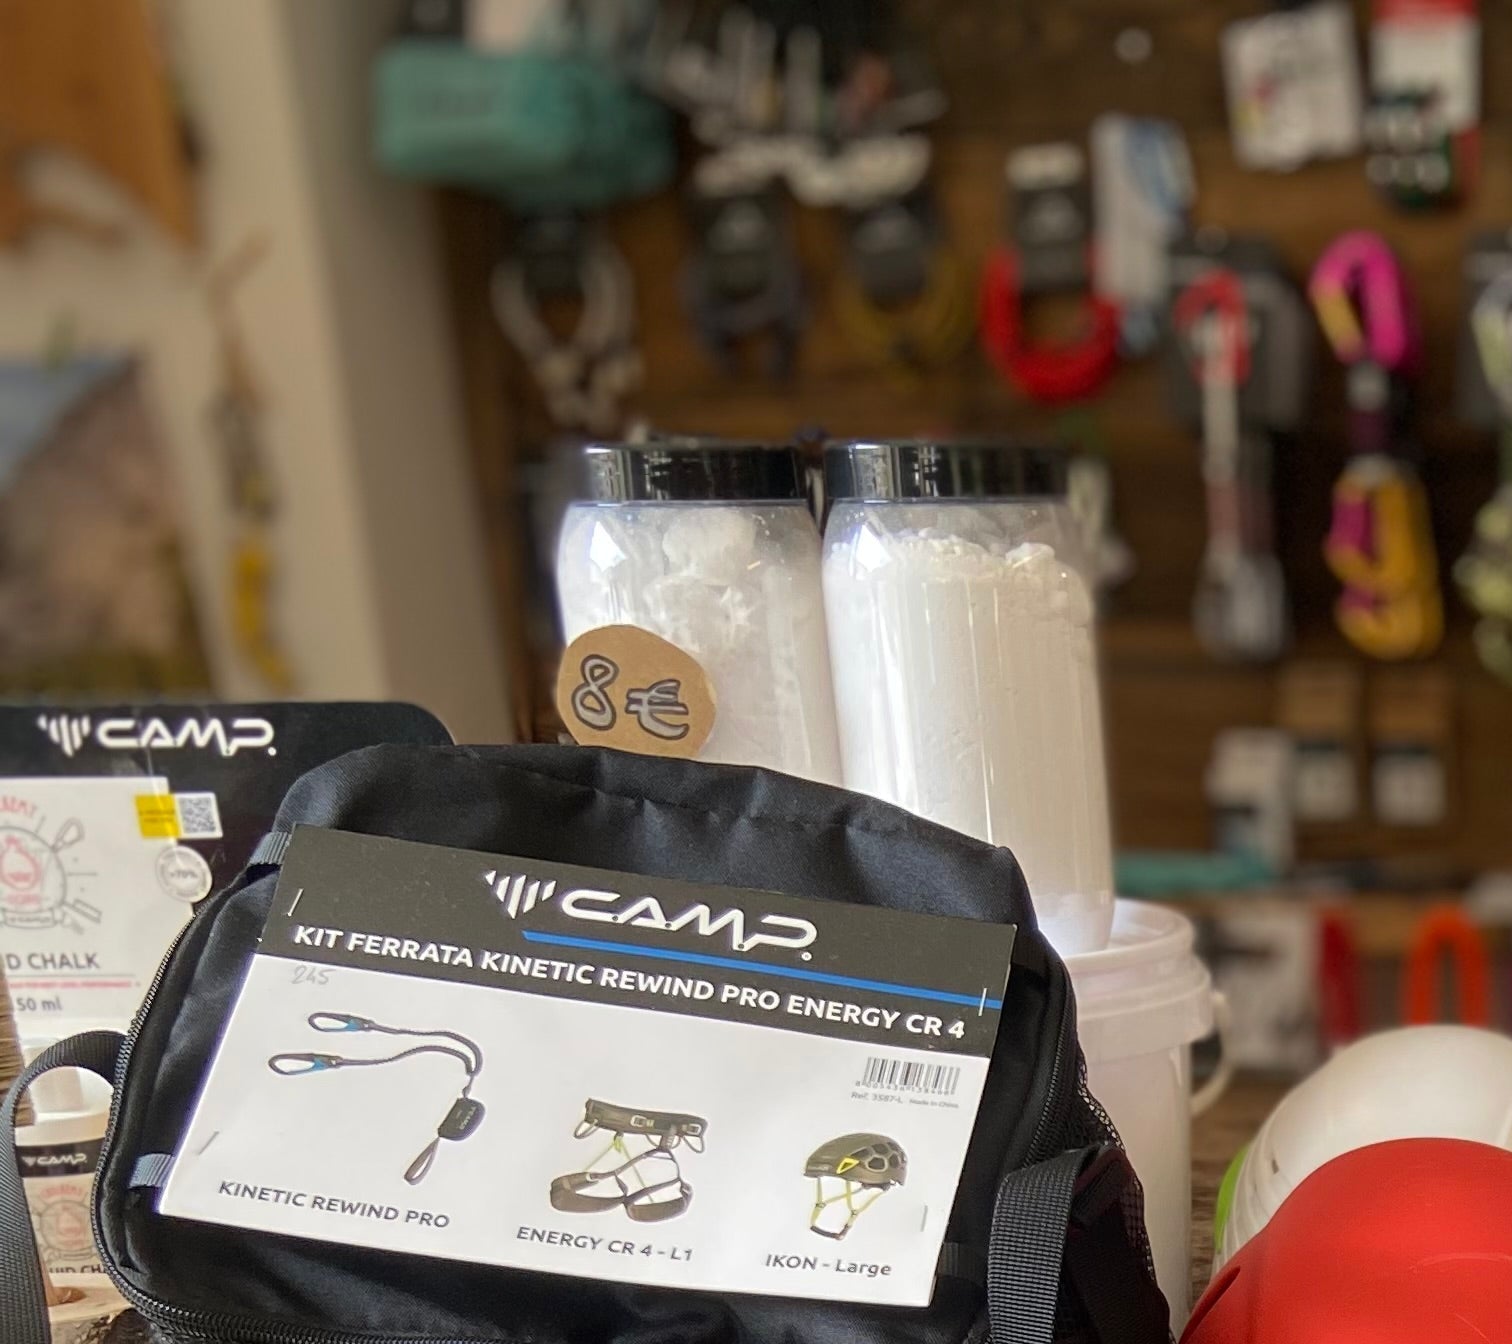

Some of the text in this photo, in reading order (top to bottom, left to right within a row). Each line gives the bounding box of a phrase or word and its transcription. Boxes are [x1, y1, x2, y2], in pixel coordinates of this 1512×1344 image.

[27, 953, 100, 970] CHALK
[294, 925, 965, 1039] KIT FERRATA KINETIC REWIND PRO ENERGY CR 4
[42, 994, 63, 1011] ml
[218, 1181, 450, 1228] KINETIC REWIND PRO
[516, 1226, 602, 1251] ENERGY
[607, 1239, 635, 1256] CR
[639, 1244, 652, 1258] 4
[670, 1247, 693, 1262] L1
[765, 1253, 817, 1271] IKON
[835, 1258, 892, 1278] Large
